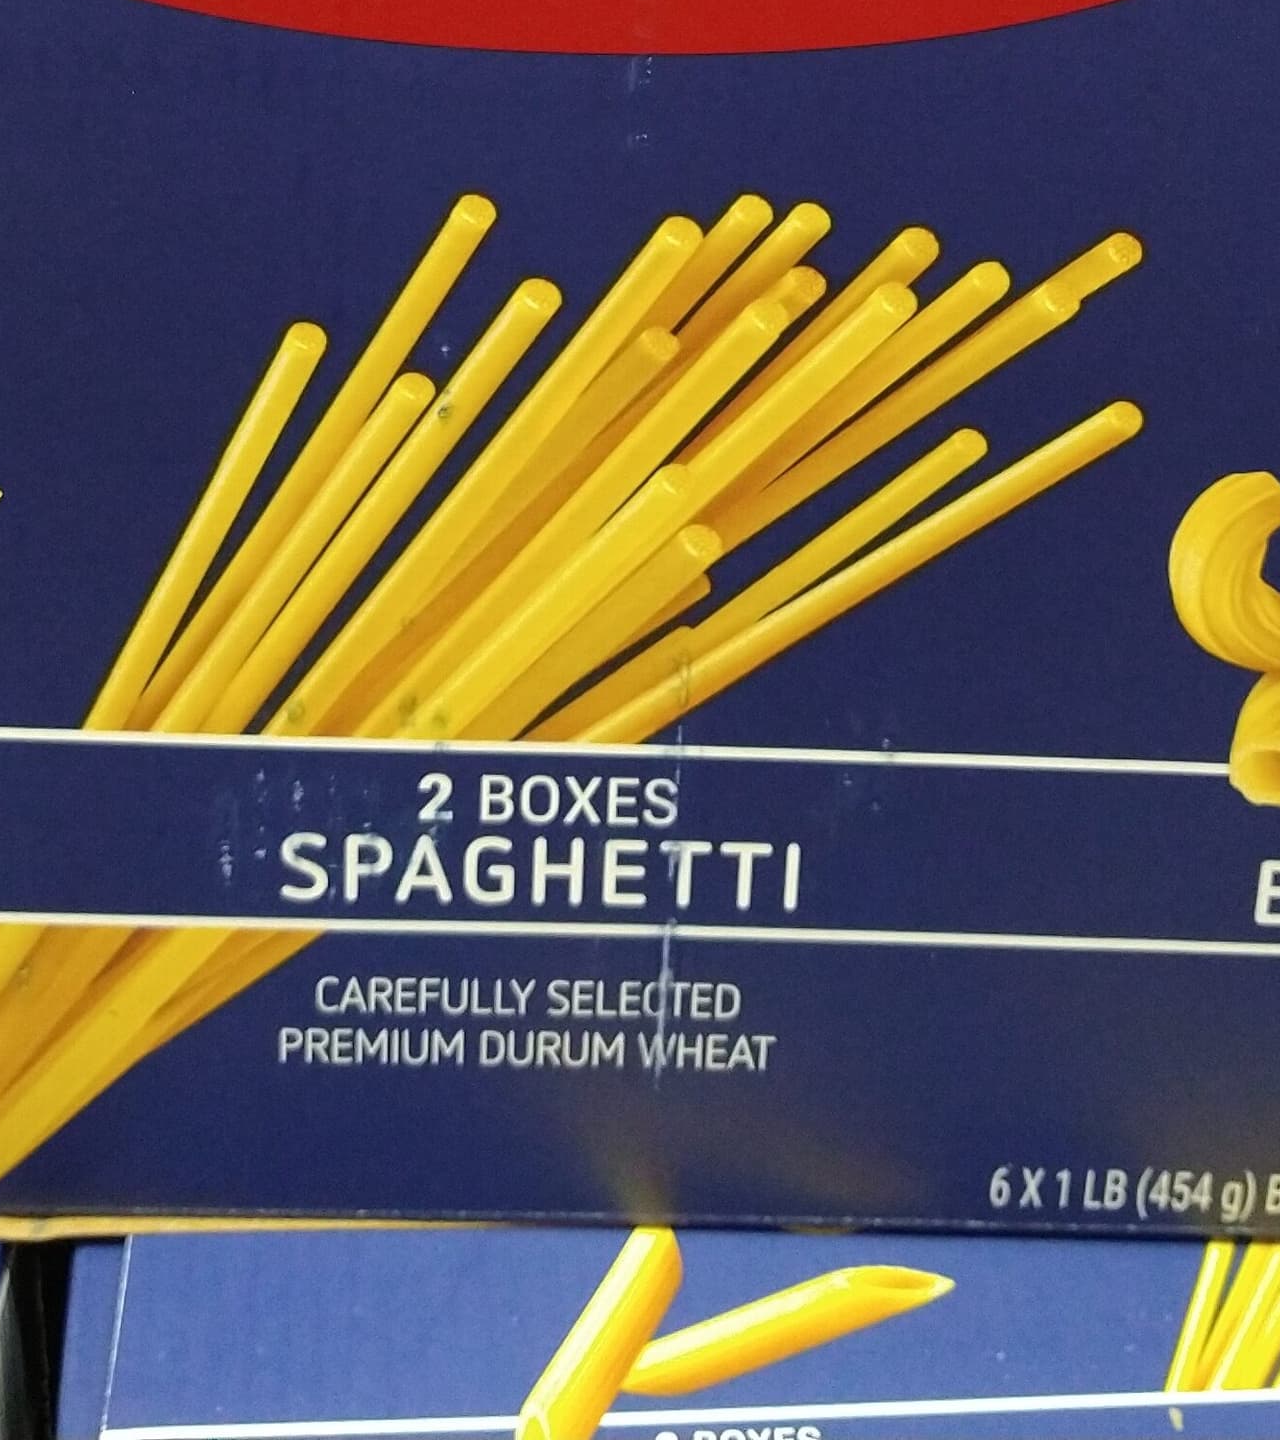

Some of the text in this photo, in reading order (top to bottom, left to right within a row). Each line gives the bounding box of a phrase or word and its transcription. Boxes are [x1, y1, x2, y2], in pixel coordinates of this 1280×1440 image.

[418, 773, 680, 826] 2 BOXES
[279, 832, 802, 913] SPAGHETTI
[315, 976, 742, 1021] CAREFULLY SELECTED
[278, 1027, 777, 1073] PREMIUM DURUM WHEAT
[989, 1167, 1011, 1209] 6
[1020, 1168, 1046, 1209] X
[1056, 1168, 1071, 1209] 1
[1083, 1169, 1128, 1211] LB
[1135, 1167, 1213, 1220] (454
[1221, 1170, 1256, 1223] g)
